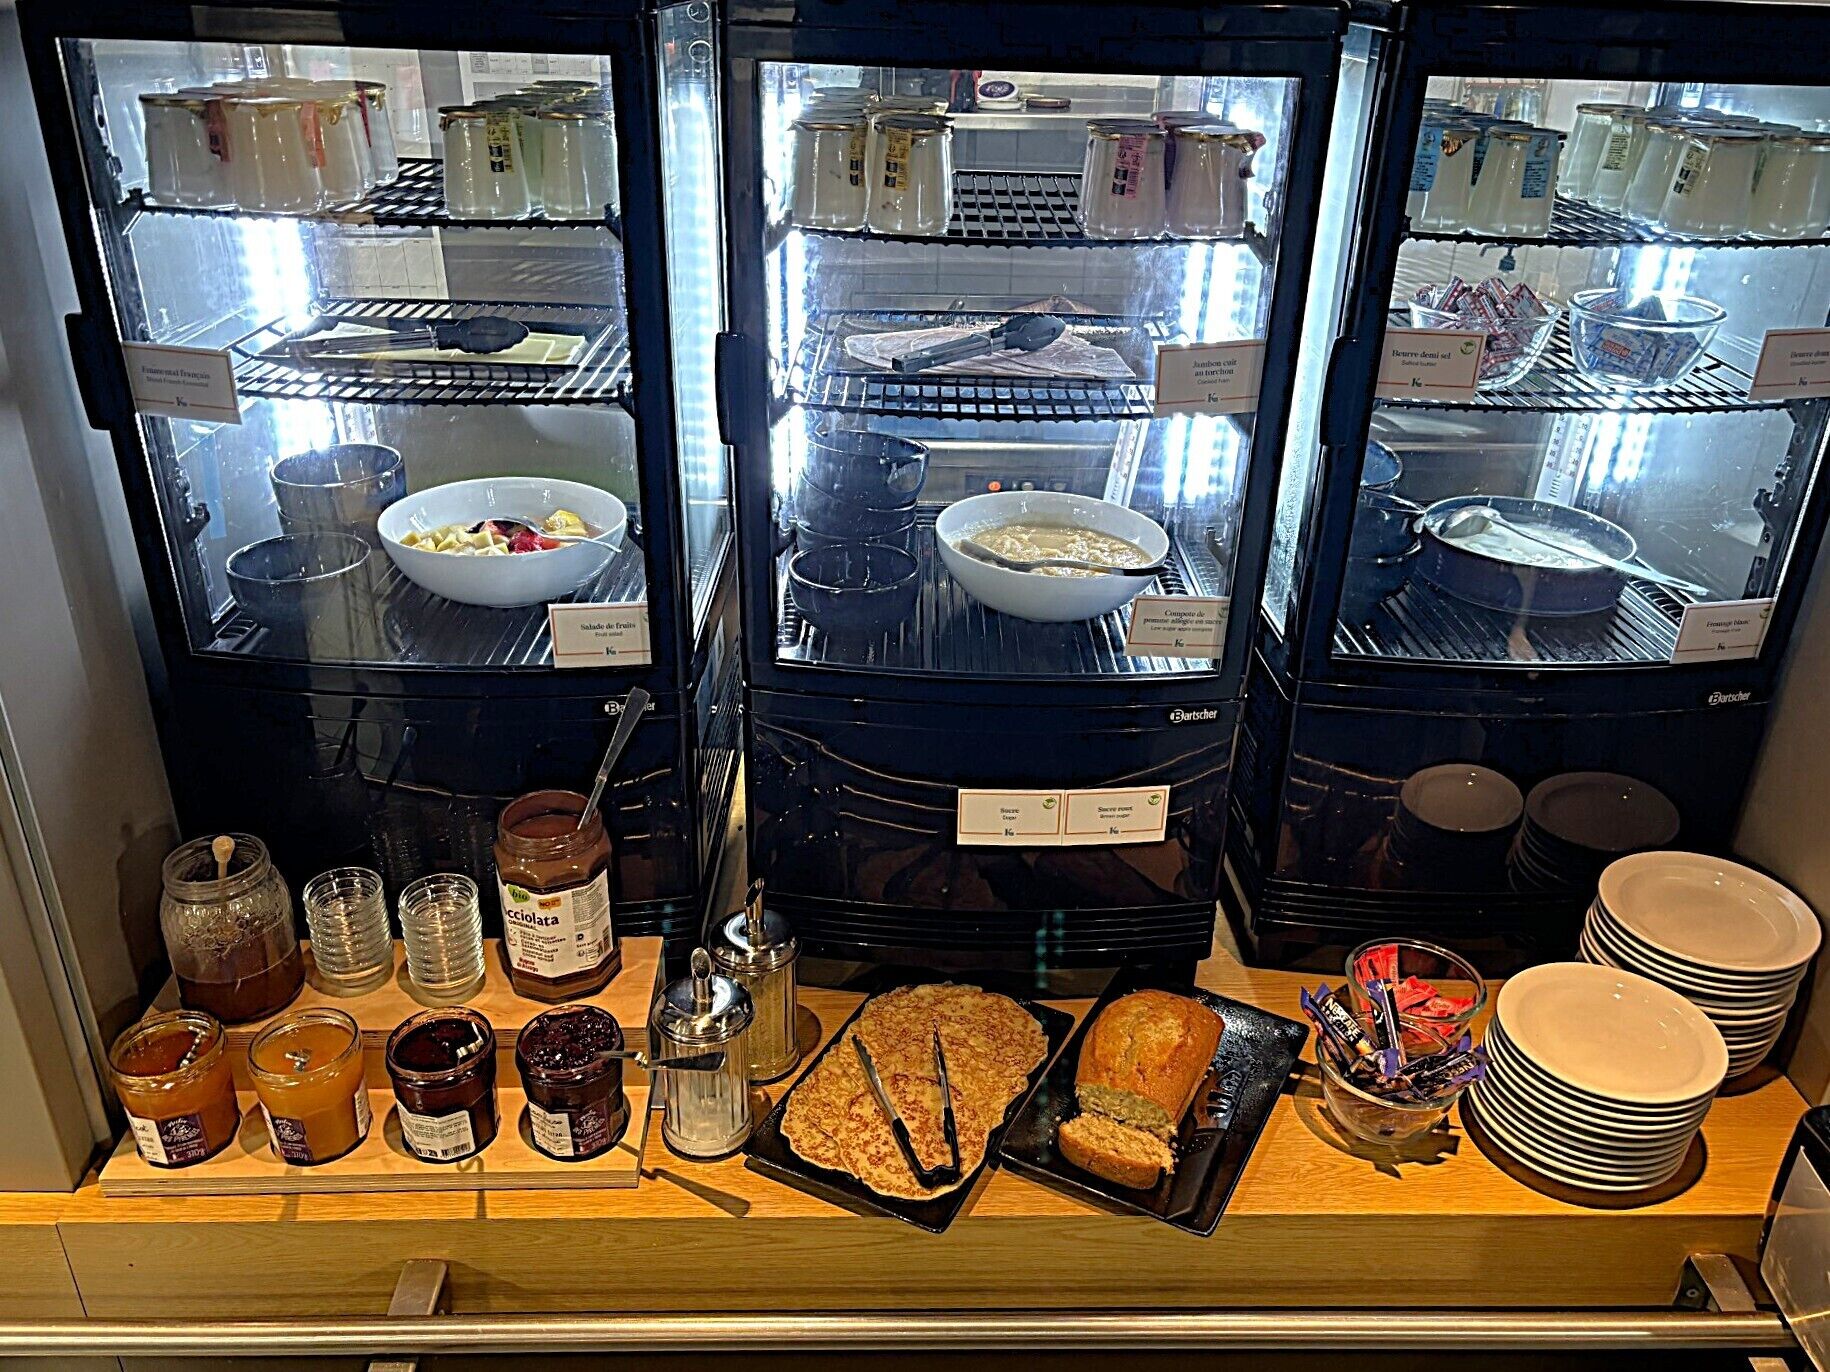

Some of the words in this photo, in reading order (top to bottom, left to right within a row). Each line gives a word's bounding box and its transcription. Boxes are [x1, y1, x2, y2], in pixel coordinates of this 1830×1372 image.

[1392, 349, 1419, 358] Beurre
[1420, 351, 1439, 359] demi
[1440, 352, 1451, 360] sel
[1192, 360, 1221, 368] Jambon
[1223, 358, 1238, 366] cuit
[180, 369, 211, 381] français
[1204, 367, 1234, 376] torchon
[1164, 609, 1196, 618] Compote
[615, 621, 636, 629] fruits
[1708, 691, 1751, 706] Bartscher
[1170, 708, 1218, 723] Bartscher
[512, 889, 529, 901] bio
[507, 909, 560, 927] cciolata
[508, 919, 537, 930] ORIGINAL
